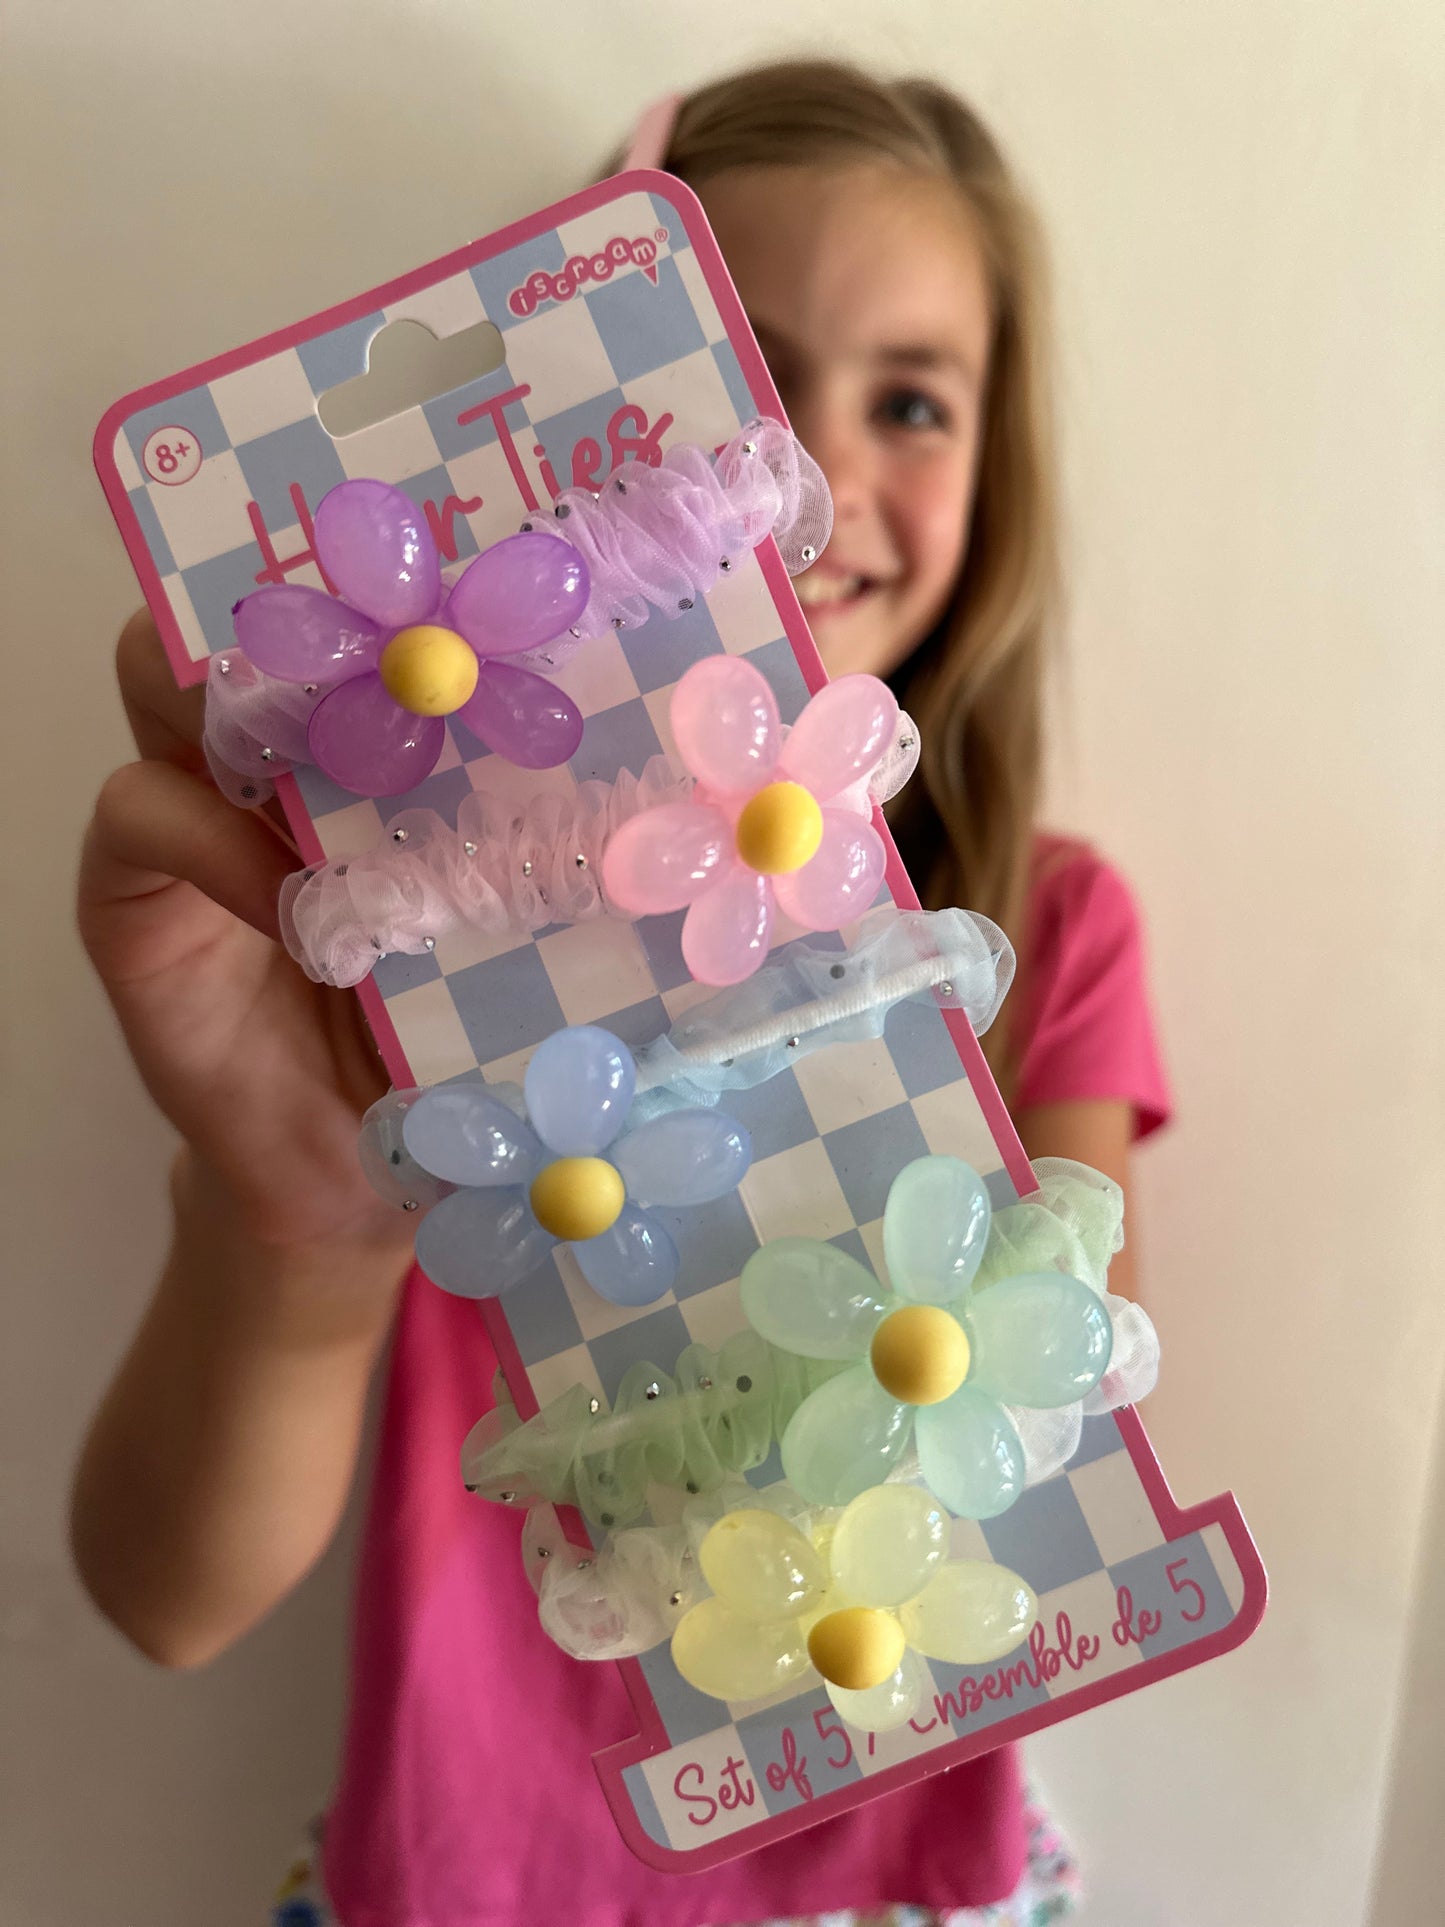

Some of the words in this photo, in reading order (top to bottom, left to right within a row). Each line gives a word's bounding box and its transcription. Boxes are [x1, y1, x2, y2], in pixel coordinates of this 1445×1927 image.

[155, 442, 191, 474] 8+
[247, 482, 484, 597] Hr
[674, 1756, 754, 1825] Set
[766, 1727, 813, 1800] of
[1112, 1586, 1162, 1647] de
[1165, 1557, 1206, 1622] 5
